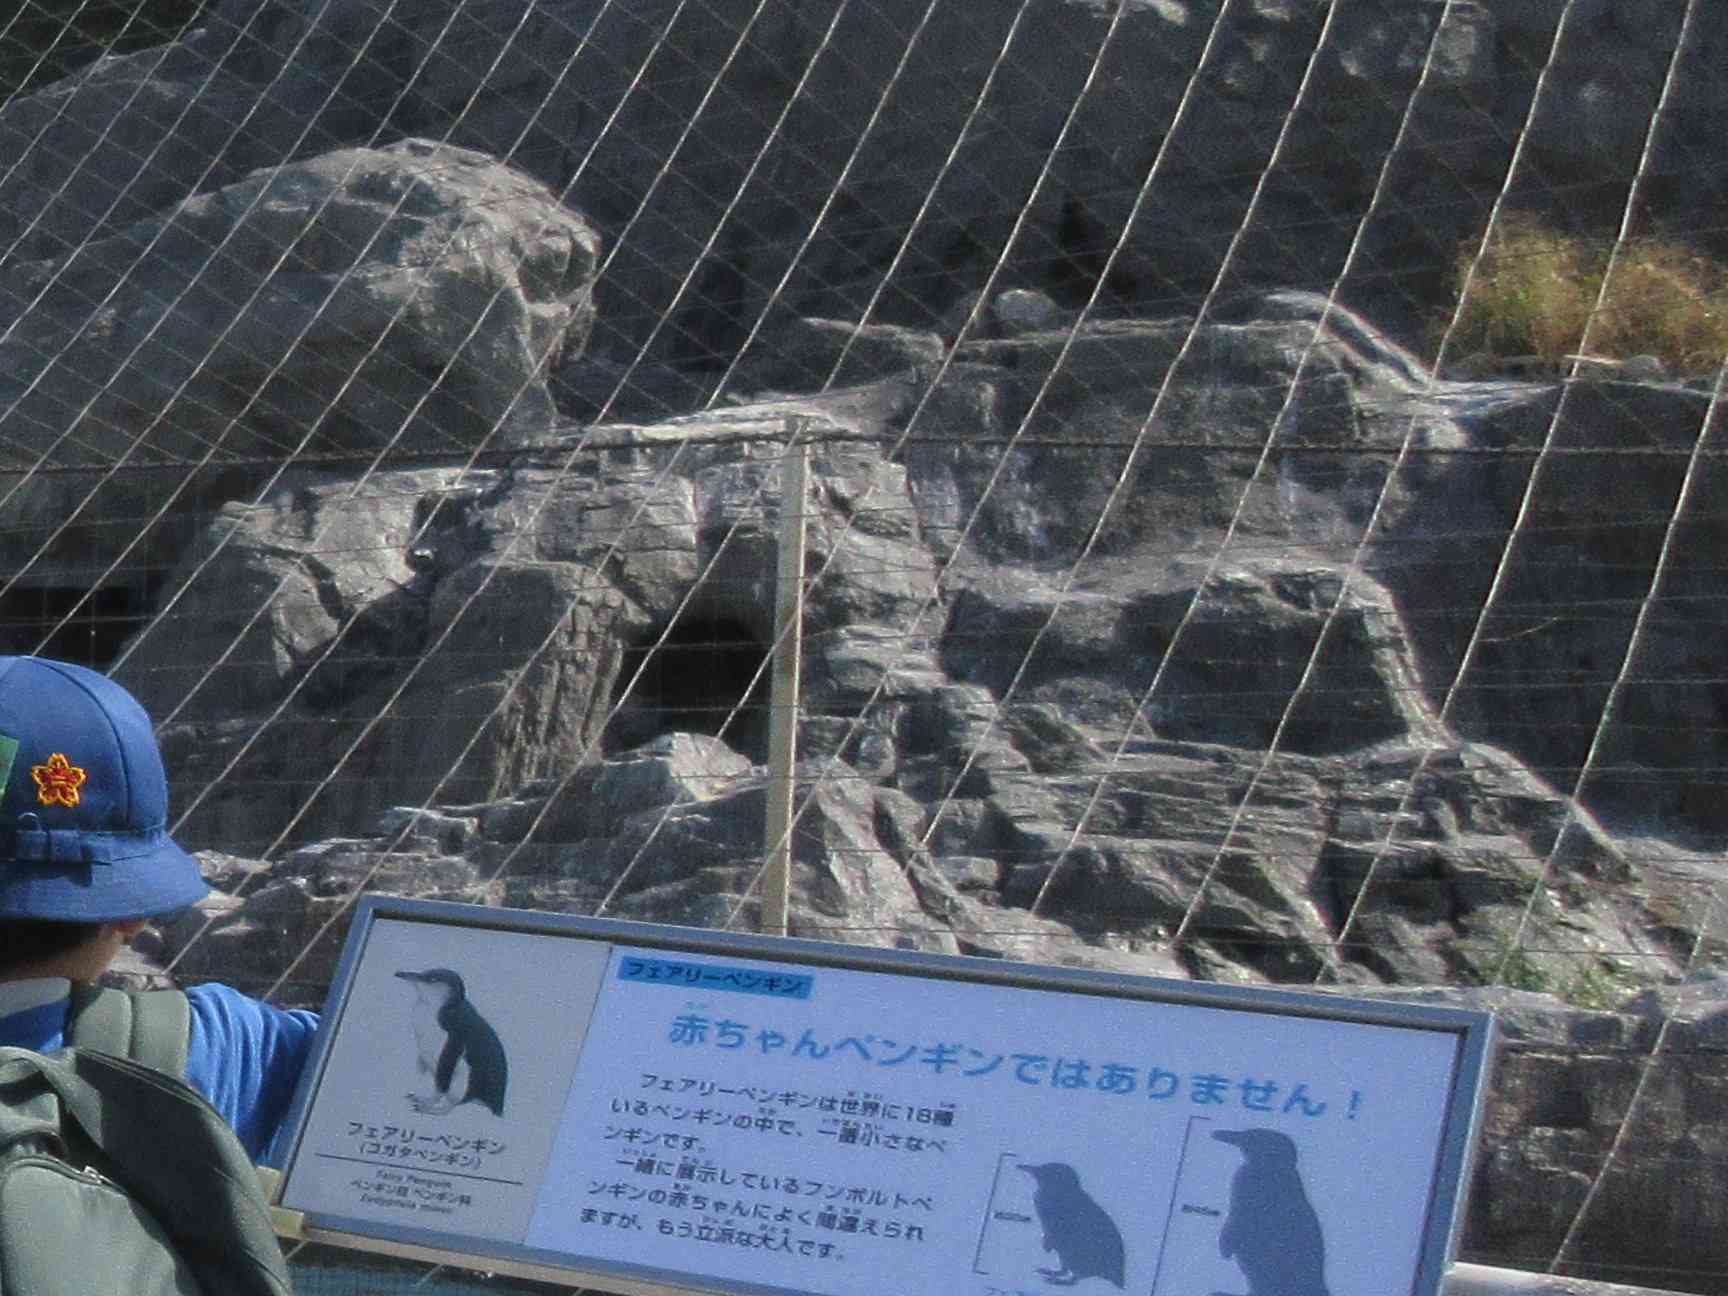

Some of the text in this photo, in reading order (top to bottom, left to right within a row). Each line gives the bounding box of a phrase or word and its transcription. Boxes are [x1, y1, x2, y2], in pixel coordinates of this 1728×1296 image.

[628, 961, 804, 995] フェアリーペンギン
[668, 1013, 1362, 1119] 赤ちゃんペンギンではありません！
[348, 1121, 506, 1155] フェアリーペンギン
